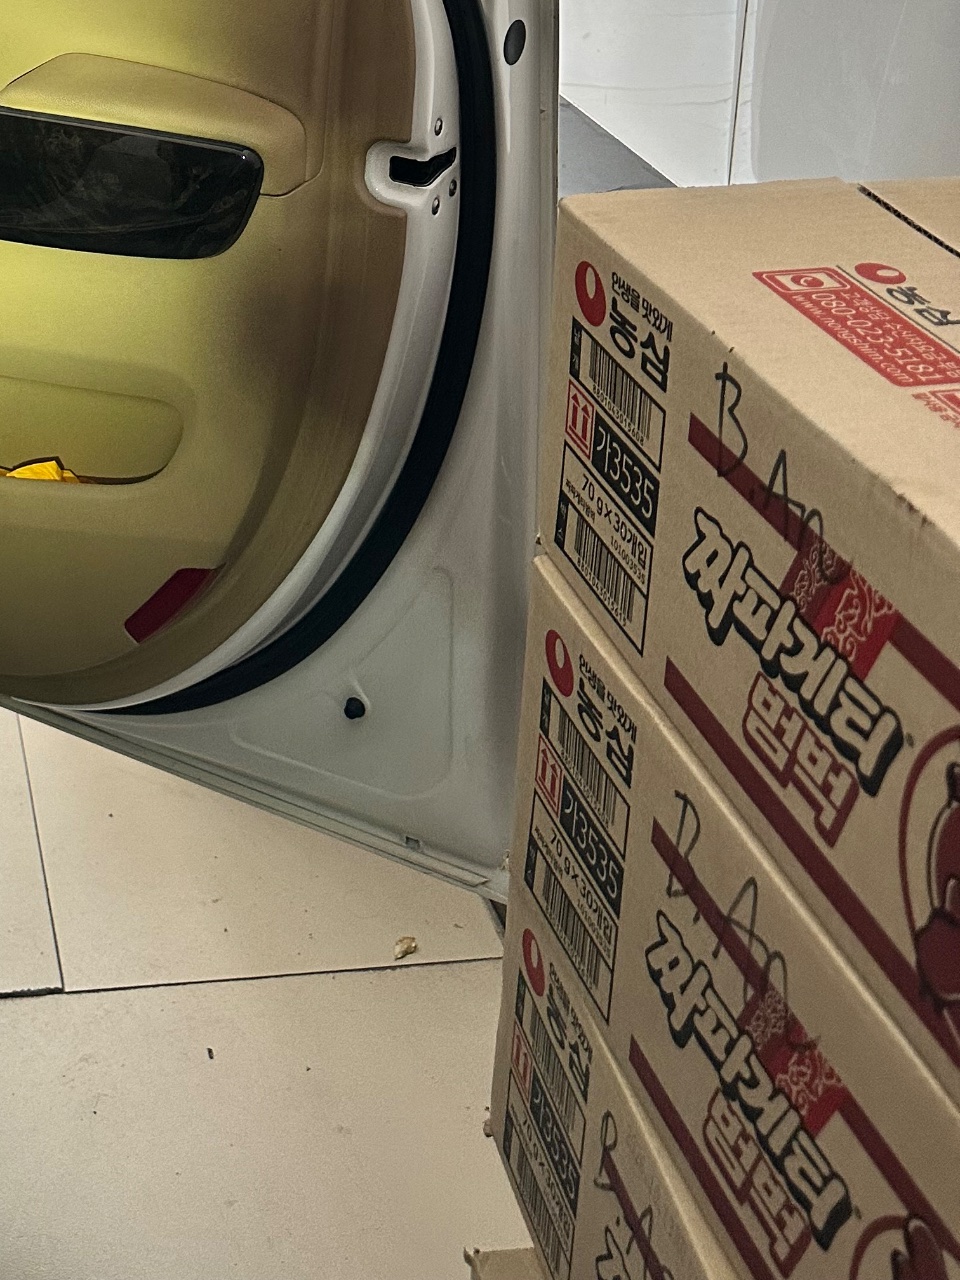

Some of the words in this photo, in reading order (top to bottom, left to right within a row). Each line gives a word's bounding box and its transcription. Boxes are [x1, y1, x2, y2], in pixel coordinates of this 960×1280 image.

[609, 296, 671, 394] 농심
[611, 271, 641, 314] 인생을
[641, 297, 674, 343] 맛있게
[791, 294, 913, 384] www.nongshim.com
[811, 292, 944, 381] 080-023-5181
[596, 425, 655, 519] 가3535
[610, 535, 646, 586] 101003535
[682, 506, 904, 798] 짜파게티
[577, 677, 635, 790] 농심
[742, 671, 861, 848] 범벅
[564, 790, 620, 900] 가3535
[547, 982, 590, 1105] 농심
[645, 909, 852, 1252] 짜파게티
[533, 1079, 577, 1200] 가3535
[703, 1086, 813, 1280] 범벅
